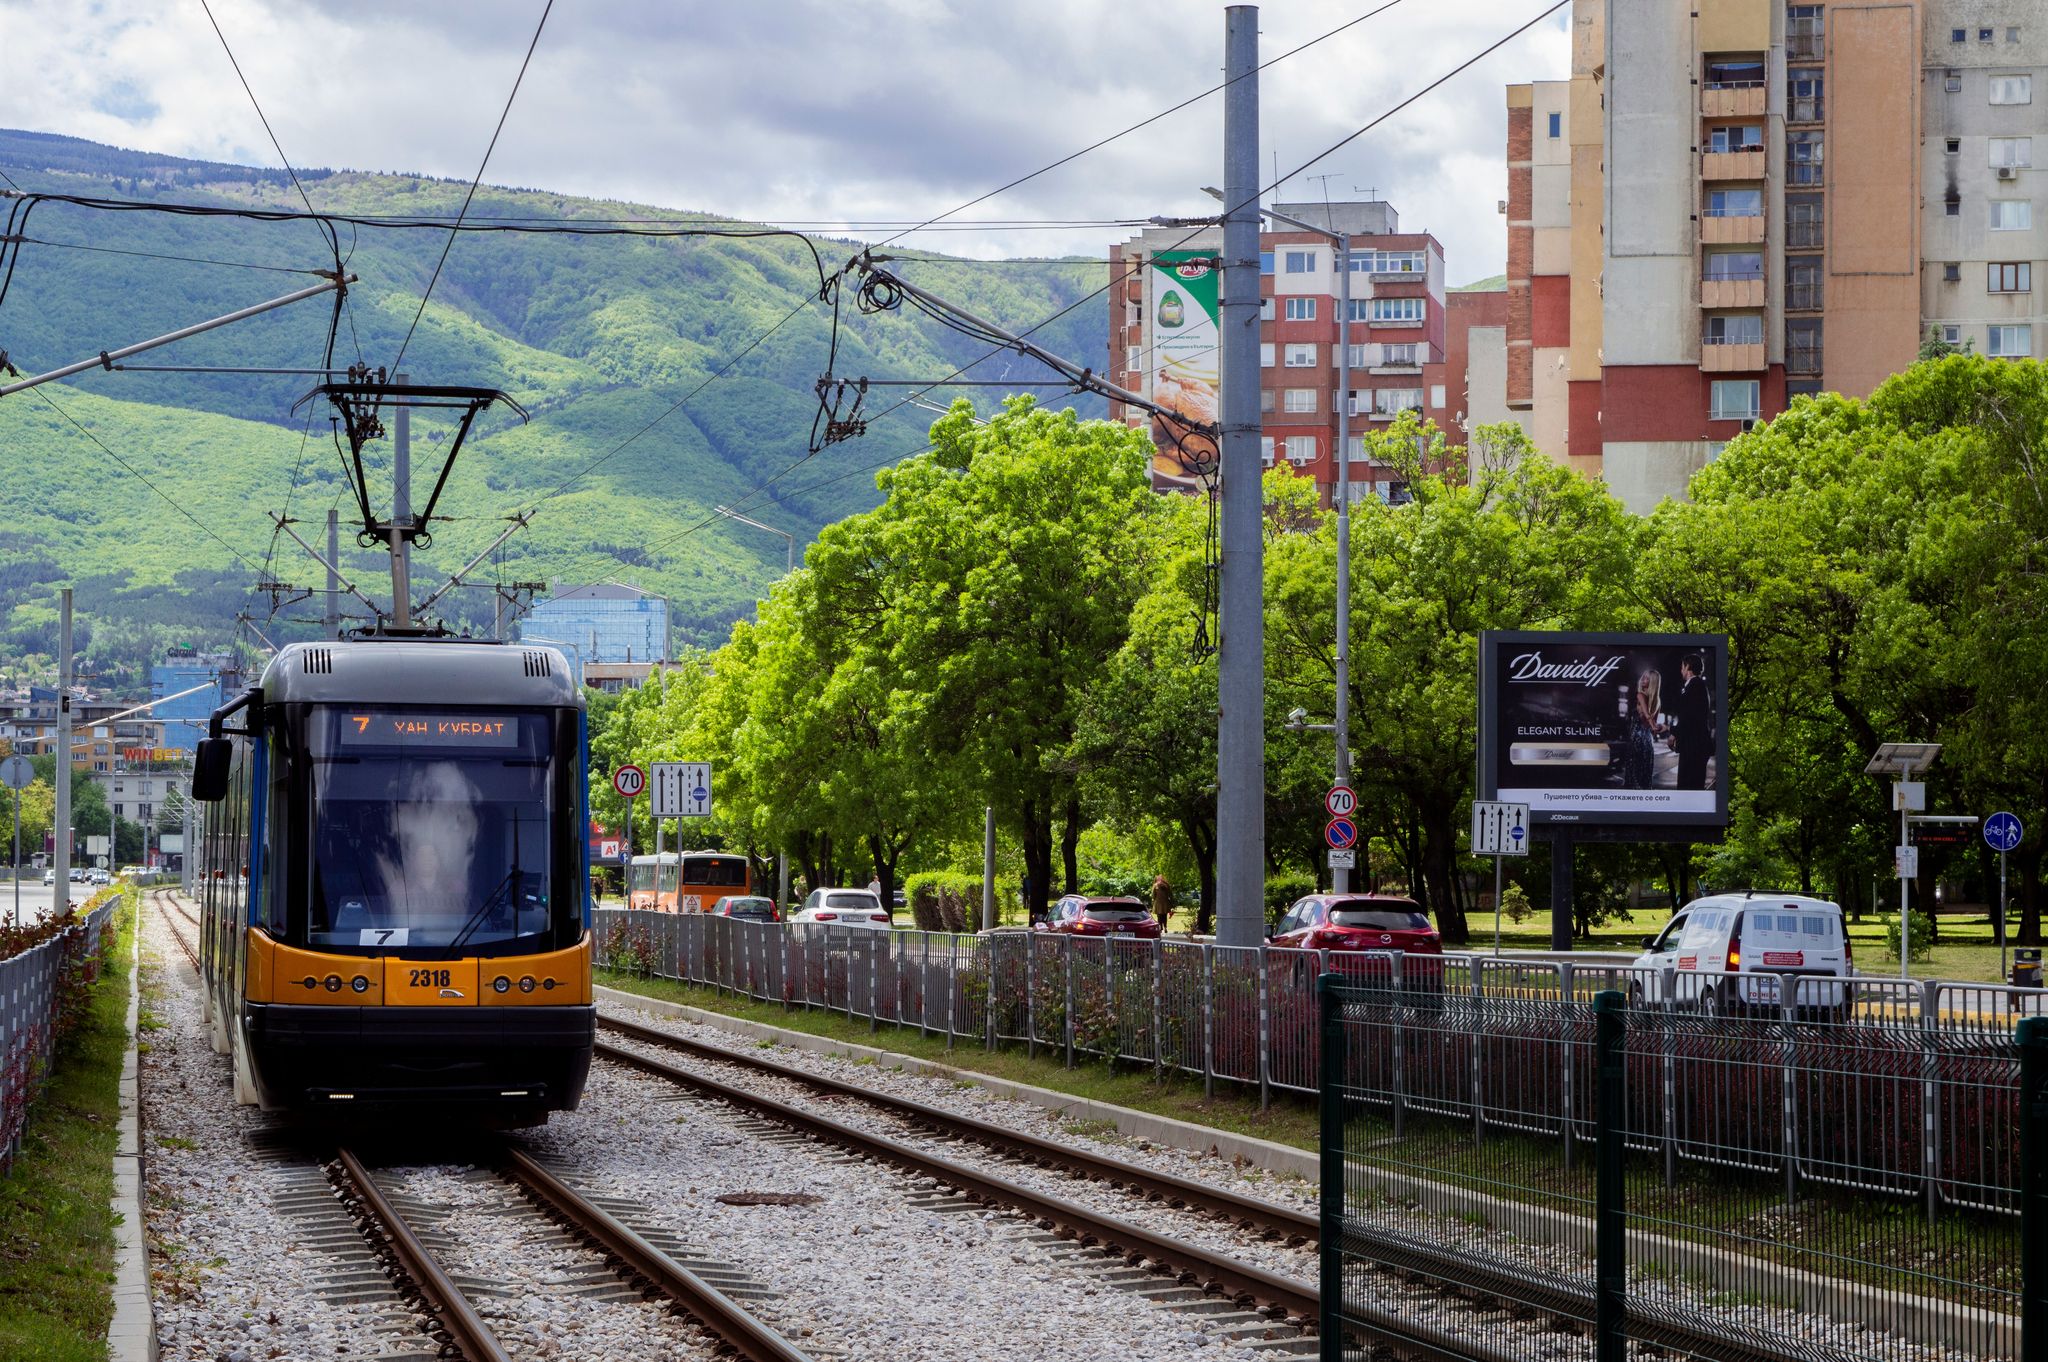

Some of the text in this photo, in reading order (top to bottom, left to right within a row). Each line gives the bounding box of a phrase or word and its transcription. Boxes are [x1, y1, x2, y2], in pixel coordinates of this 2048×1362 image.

[1509, 651, 1626, 687] Davidoff
[352, 717, 370, 734] 7
[1517, 726, 1601, 736] ELEGANT SL-LINE
[124, 748, 183, 761] WINBET
[621, 773, 640, 790] 70
[1332, 793, 1352, 810] 70
[1543, 793, 1580, 802] Пушенето
[1580, 793, 1602, 802] убива
[1654, 795, 1671, 803] сега
[374, 930, 395, 945] 7
[409, 969, 451, 988] 2318
